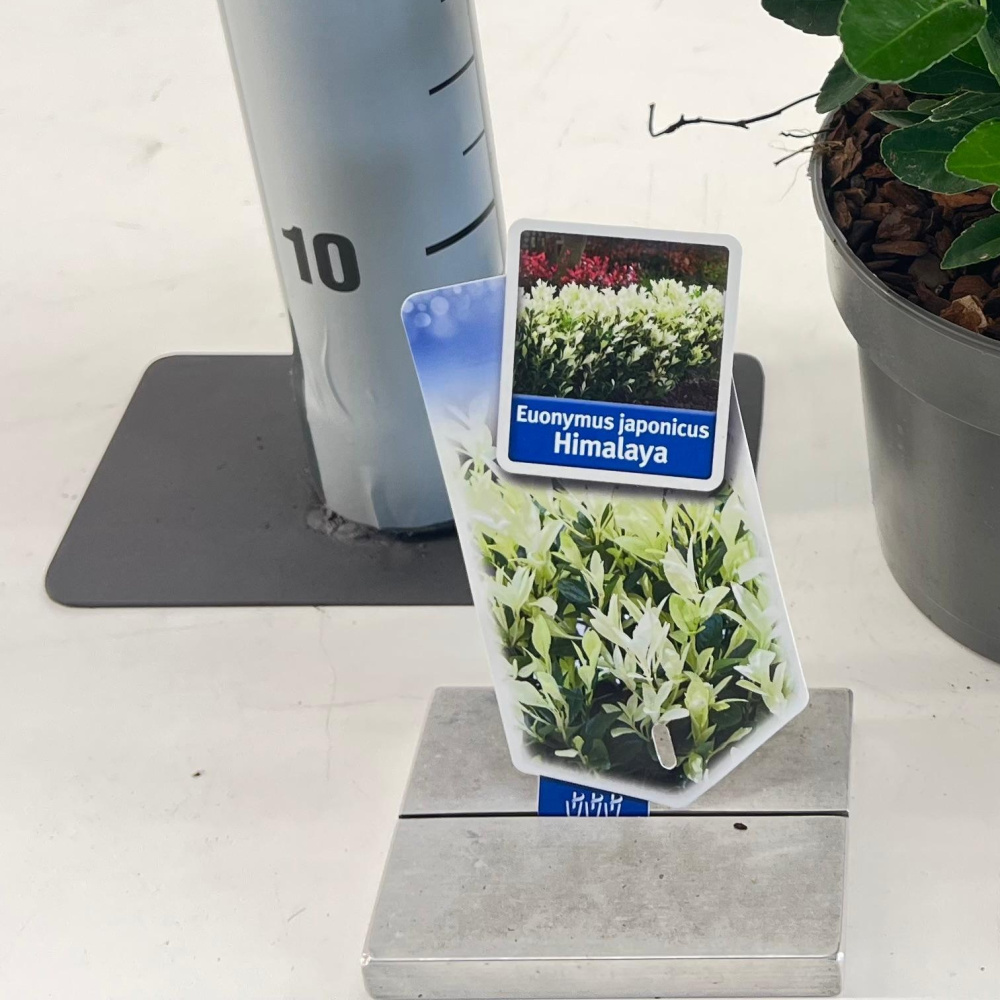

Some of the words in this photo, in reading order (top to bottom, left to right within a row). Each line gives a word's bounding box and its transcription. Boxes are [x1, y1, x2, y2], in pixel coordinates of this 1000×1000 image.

[281, 225, 361, 293] 10
[516, 404, 615, 431] Euonymus
[617, 413, 710, 439] japonicus
[553, 431, 668, 468] Himalaya
